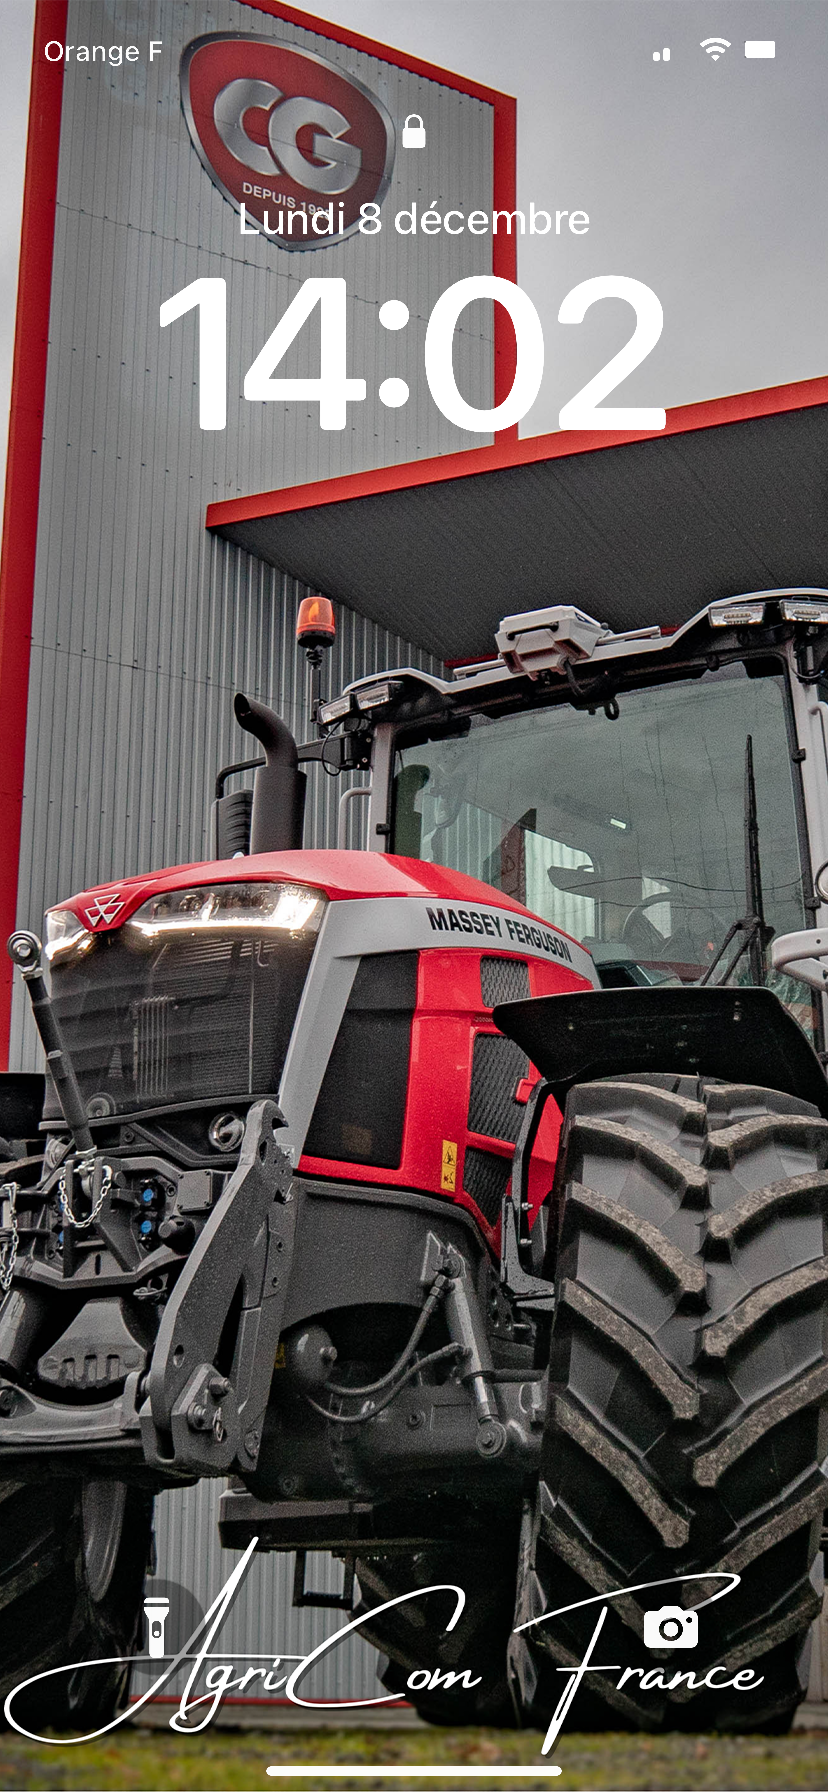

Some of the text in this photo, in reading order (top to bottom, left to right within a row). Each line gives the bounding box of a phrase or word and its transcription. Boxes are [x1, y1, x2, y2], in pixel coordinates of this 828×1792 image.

[213, 78, 363, 195] CG
[242, 182, 297, 209] DEPUIS
[425, 907, 573, 963] MASSEY FERGUSON
